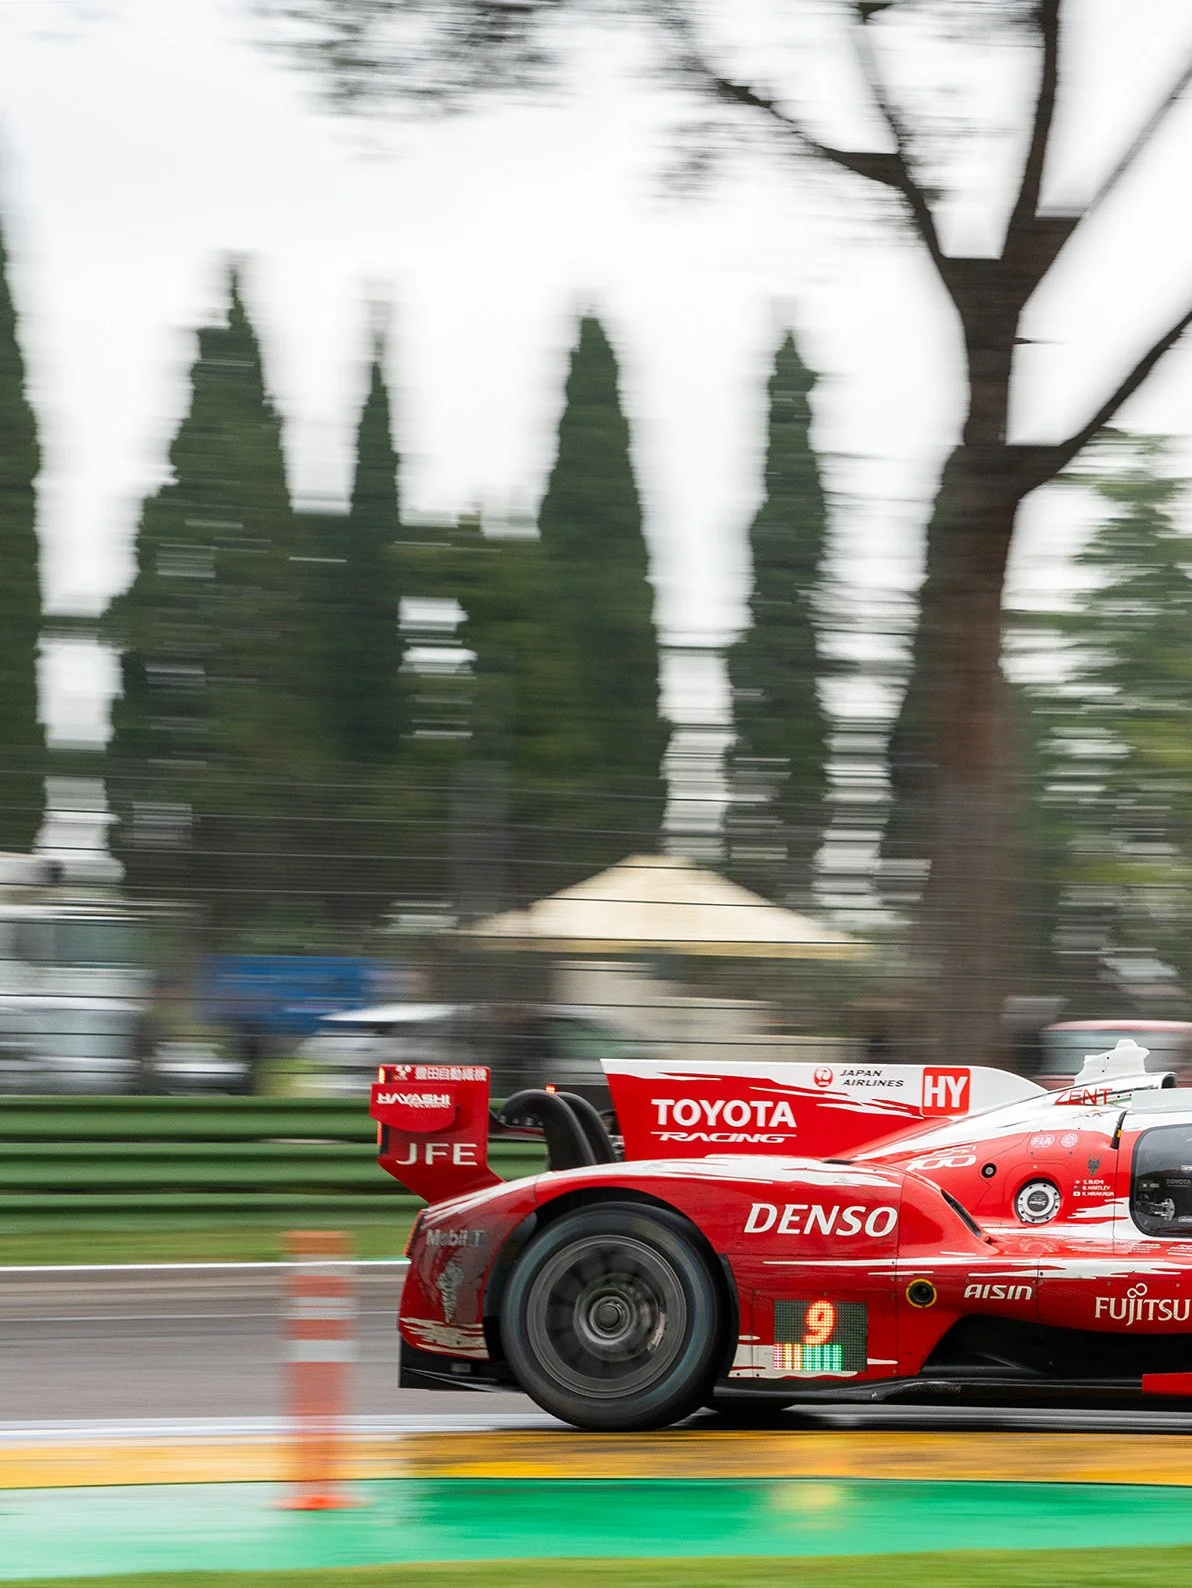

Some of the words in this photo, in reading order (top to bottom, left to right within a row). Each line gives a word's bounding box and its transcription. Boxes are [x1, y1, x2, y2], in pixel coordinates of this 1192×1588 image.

[840, 1069, 882, 1077] JAPAN
[843, 1079, 904, 1087] AIRLINES
[924, 1075, 969, 1108] HY
[376, 1093, 451, 1105] HAYASHI
[1055, 1088, 1113, 1106] ZENT
[651, 1099, 797, 1128] TOYOTA
[651, 1131, 797, 1143] RACING
[395, 1143, 478, 1165] JFE
[744, 1203, 898, 1237] DENSO
[426, 1229, 468, 1246] Mobil
[964, 1284, 1033, 1300] AISIN
[1095, 1283, 1191, 1326] FUJITSU
[803, 1300, 835, 1346] 9
